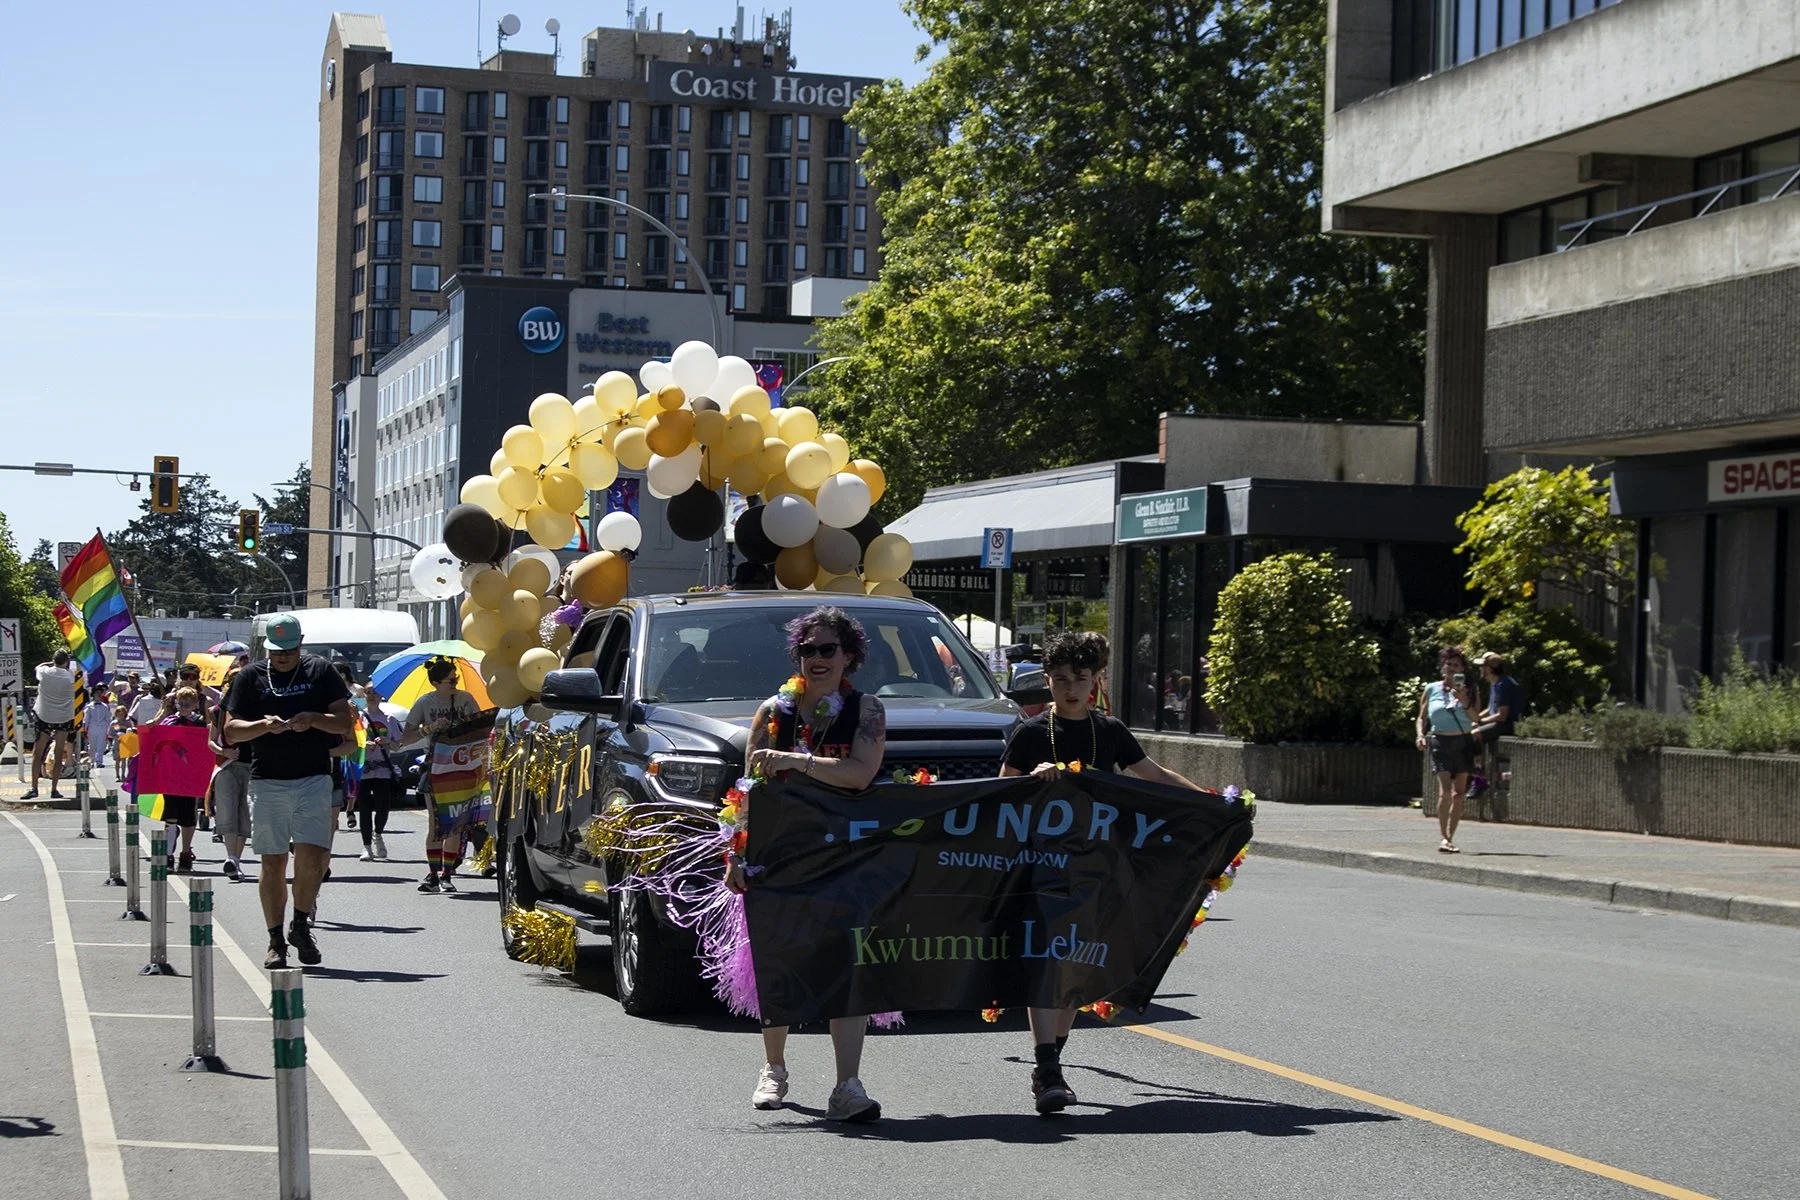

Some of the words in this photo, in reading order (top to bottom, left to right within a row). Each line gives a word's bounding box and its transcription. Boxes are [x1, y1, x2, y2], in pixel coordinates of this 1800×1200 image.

[670, 69, 757, 101] Coast
[523, 320, 560, 341] BW
[598, 312, 649, 334] Best
[576, 333, 672, 356] Western
[901, 574, 956, 588] IREHOUSE
[960, 576, 990, 590] GRILL
